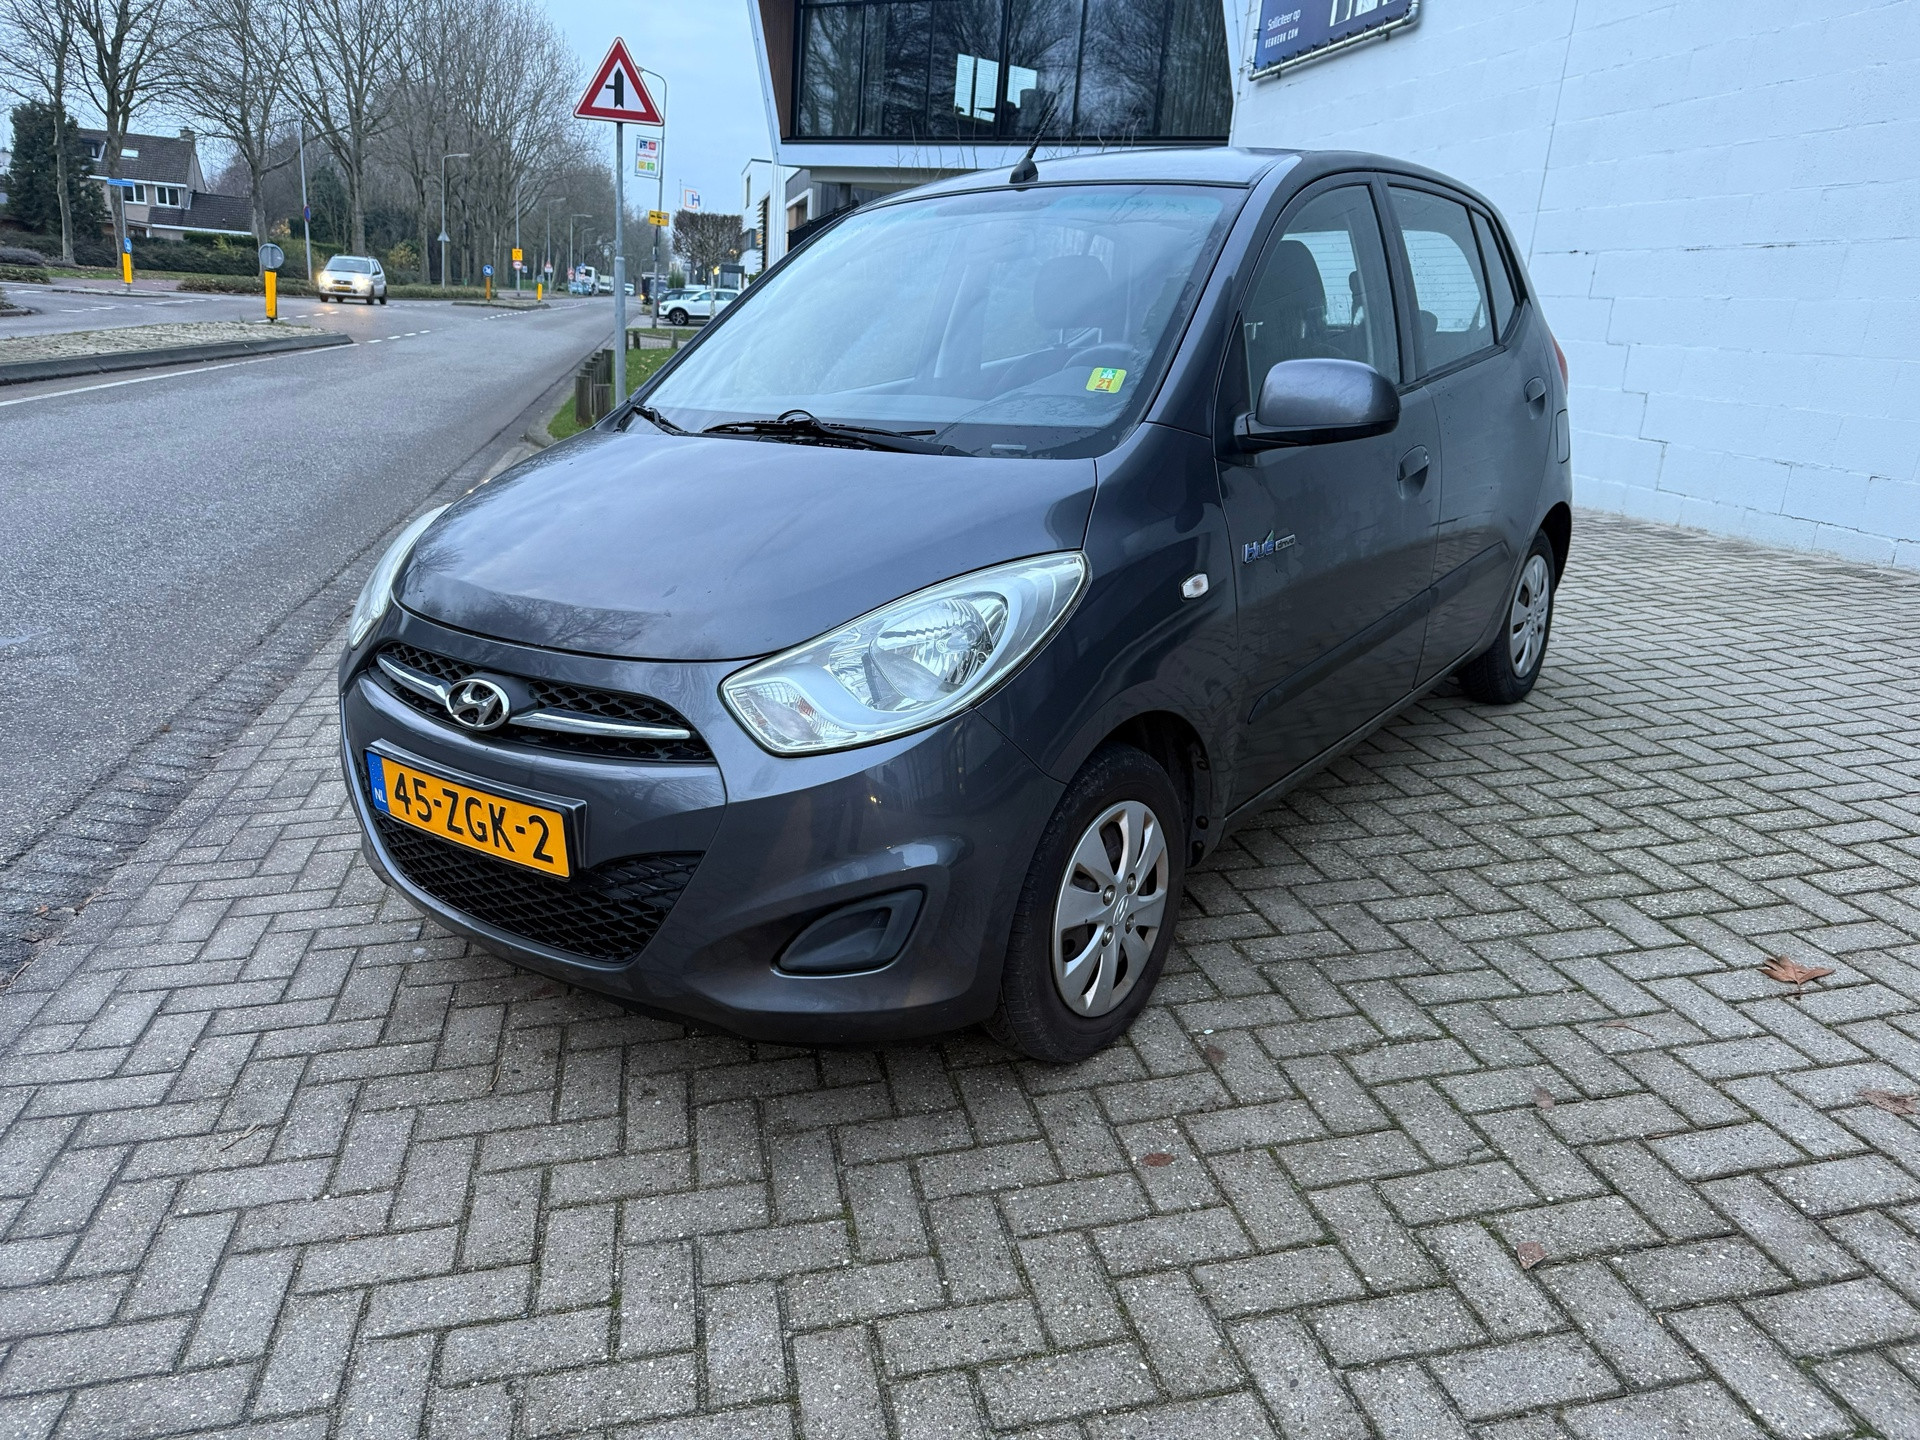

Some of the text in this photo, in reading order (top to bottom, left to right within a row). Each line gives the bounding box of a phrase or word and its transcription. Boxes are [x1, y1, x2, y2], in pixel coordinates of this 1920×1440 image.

[1293, 9, 1301, 22] op
[1096, 379, 1112, 389] 21
[374, 787, 387, 803] NL
[394, 772, 554, 864] 45-ZGK-2
